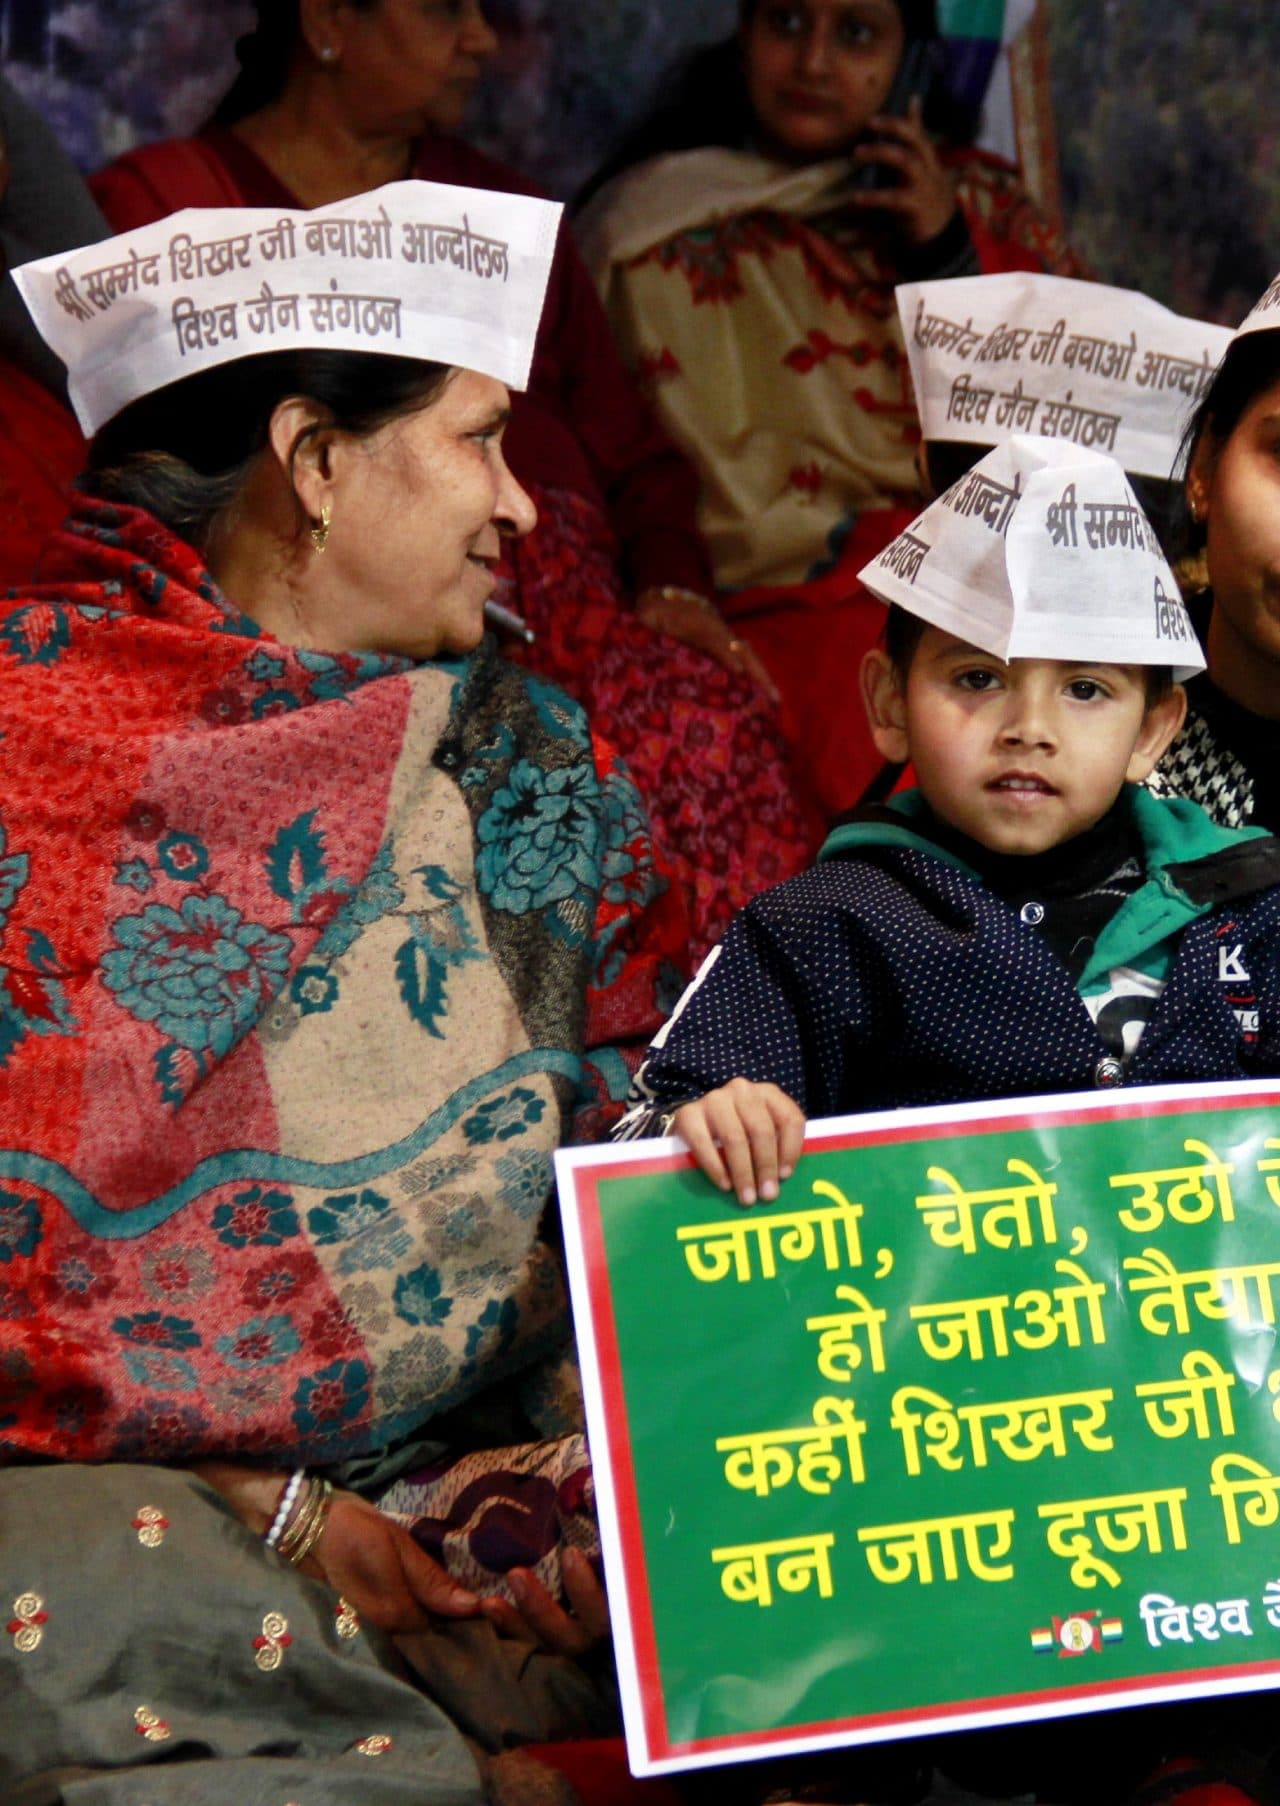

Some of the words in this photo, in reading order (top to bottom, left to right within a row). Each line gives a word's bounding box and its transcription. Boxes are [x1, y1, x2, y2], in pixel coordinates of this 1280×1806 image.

[54, 266, 95, 322] श्री
[80, 247, 161, 311] सम्मेद
[168, 231, 253, 283] शिखर
[257, 217, 297, 262] जी
[304, 205, 393, 260] बचाओ
[401, 213, 509, 284] आन्दोलन
[172, 289, 238, 356] विश्व
[245, 281, 300, 335] जैन
[307, 278, 403, 339] संगठन
[1030, 318, 1067, 366] जी
[1062, 329, 1138, 382] बचाओ
[1135, 346, 1216, 403] आन्दो
[946, 373, 995, 428] विश्व
[994, 378, 1038, 433] जैन
[1038, 389, 1122, 452] संगठन
[953, 471, 1022, 538] आन्दो
[1045, 482, 1079, 549] श्री
[1083, 487, 1146, 552] सम्मेद
[676, 1178, 895, 1283] जागो,
[916, 1157, 1090, 1255] चेतो,
[1109, 1137, 1236, 1233] उठो
[807, 1284, 887, 1383] हो
[909, 1258, 1107, 1361] जाओ
[715, 1395, 867, 1497] कहीं
[890, 1385, 1114, 1476] शिखर
[1136, 1348, 1237, 1441] जी
[711, 1533, 835, 1606] बन
[857, 1508, 1015, 1584] जाए
[1037, 1486, 1188, 1590] दूजा
[1138, 1592, 1254, 1648] विश्व
